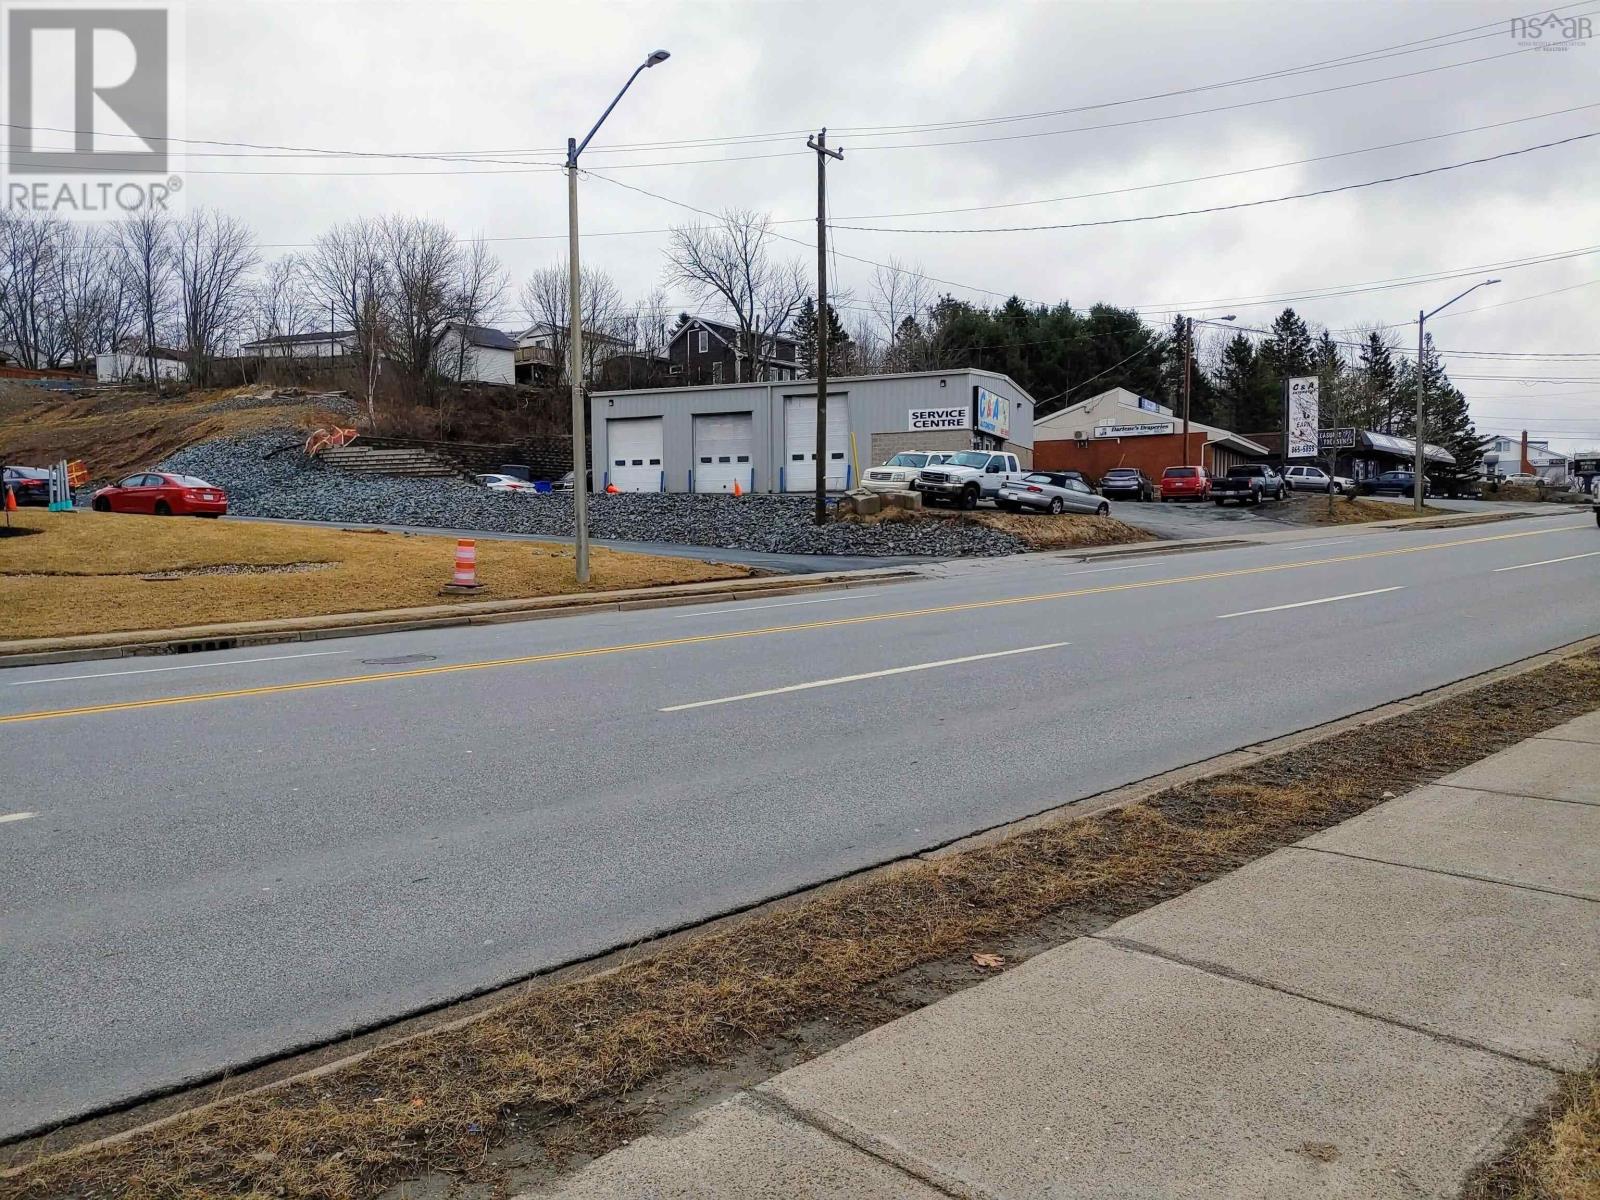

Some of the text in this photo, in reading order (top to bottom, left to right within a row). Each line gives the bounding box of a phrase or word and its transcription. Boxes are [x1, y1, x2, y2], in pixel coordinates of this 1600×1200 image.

[979, 390, 986, 418] C
[992, 397, 999, 420] A
[911, 409, 966, 420] SERVICE
[913, 418, 964, 429] CENTRE
